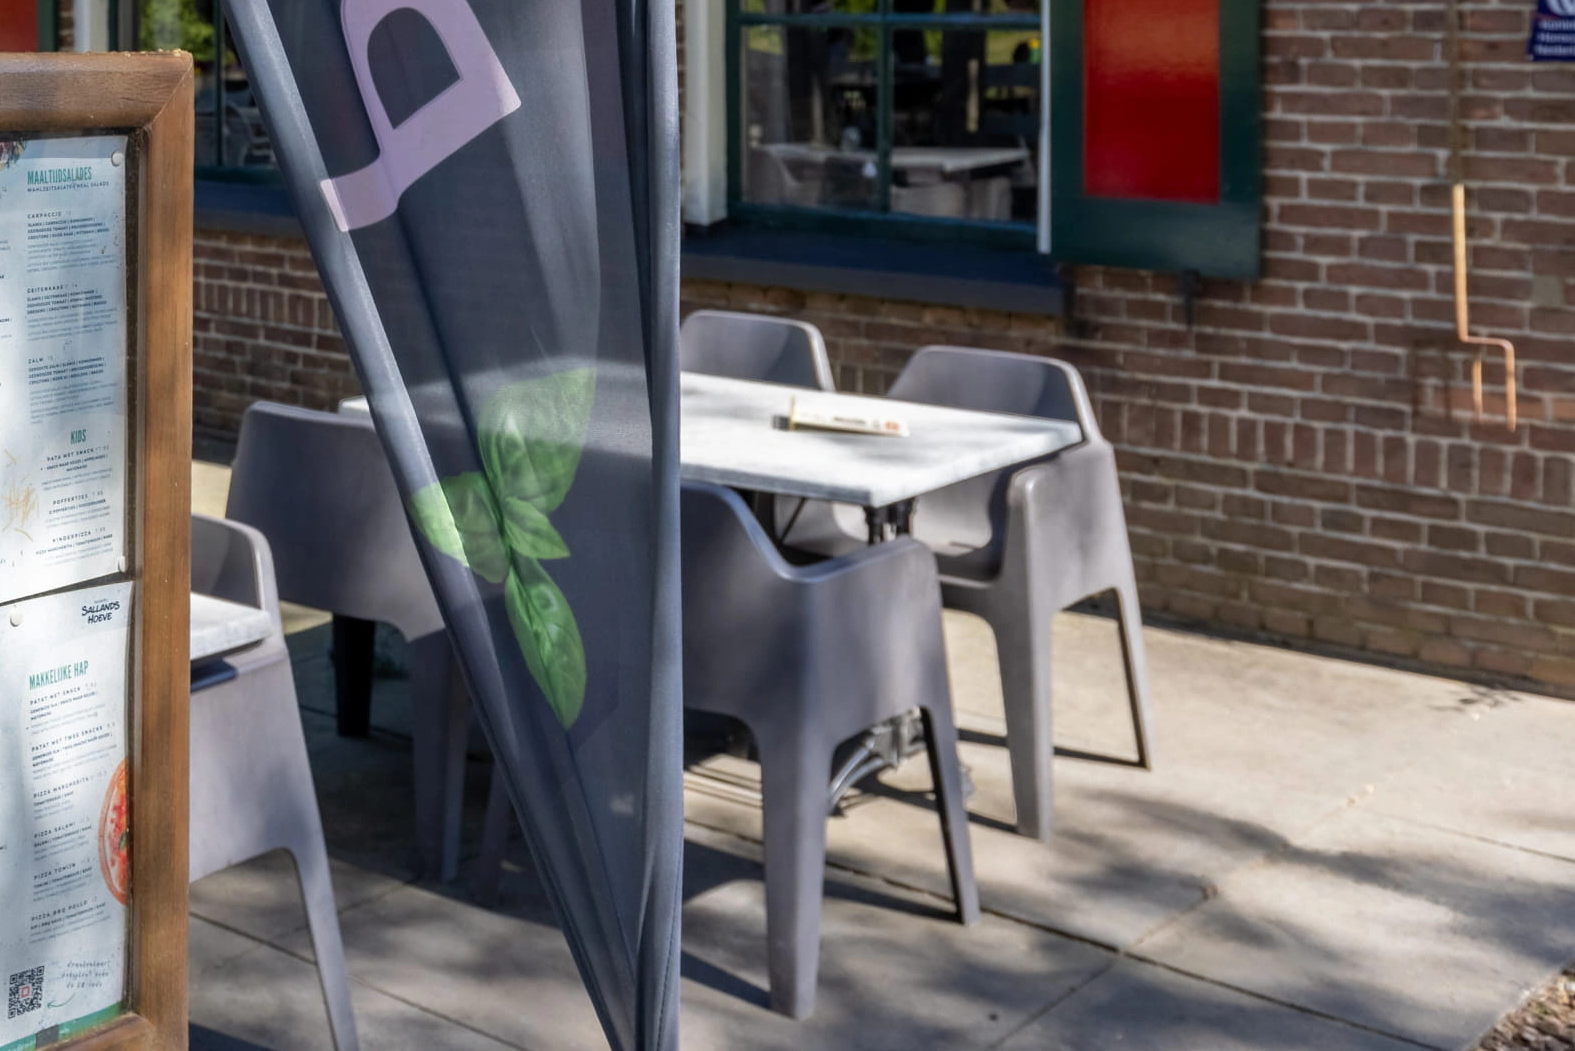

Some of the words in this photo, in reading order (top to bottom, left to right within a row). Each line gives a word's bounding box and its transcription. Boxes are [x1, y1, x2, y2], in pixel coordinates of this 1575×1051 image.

[70, 429, 87, 444] KIDS
[81, 601, 120, 616] SALLANDS
[87, 612, 113, 624] HOEVE
[74, 661, 89, 678] HAP
